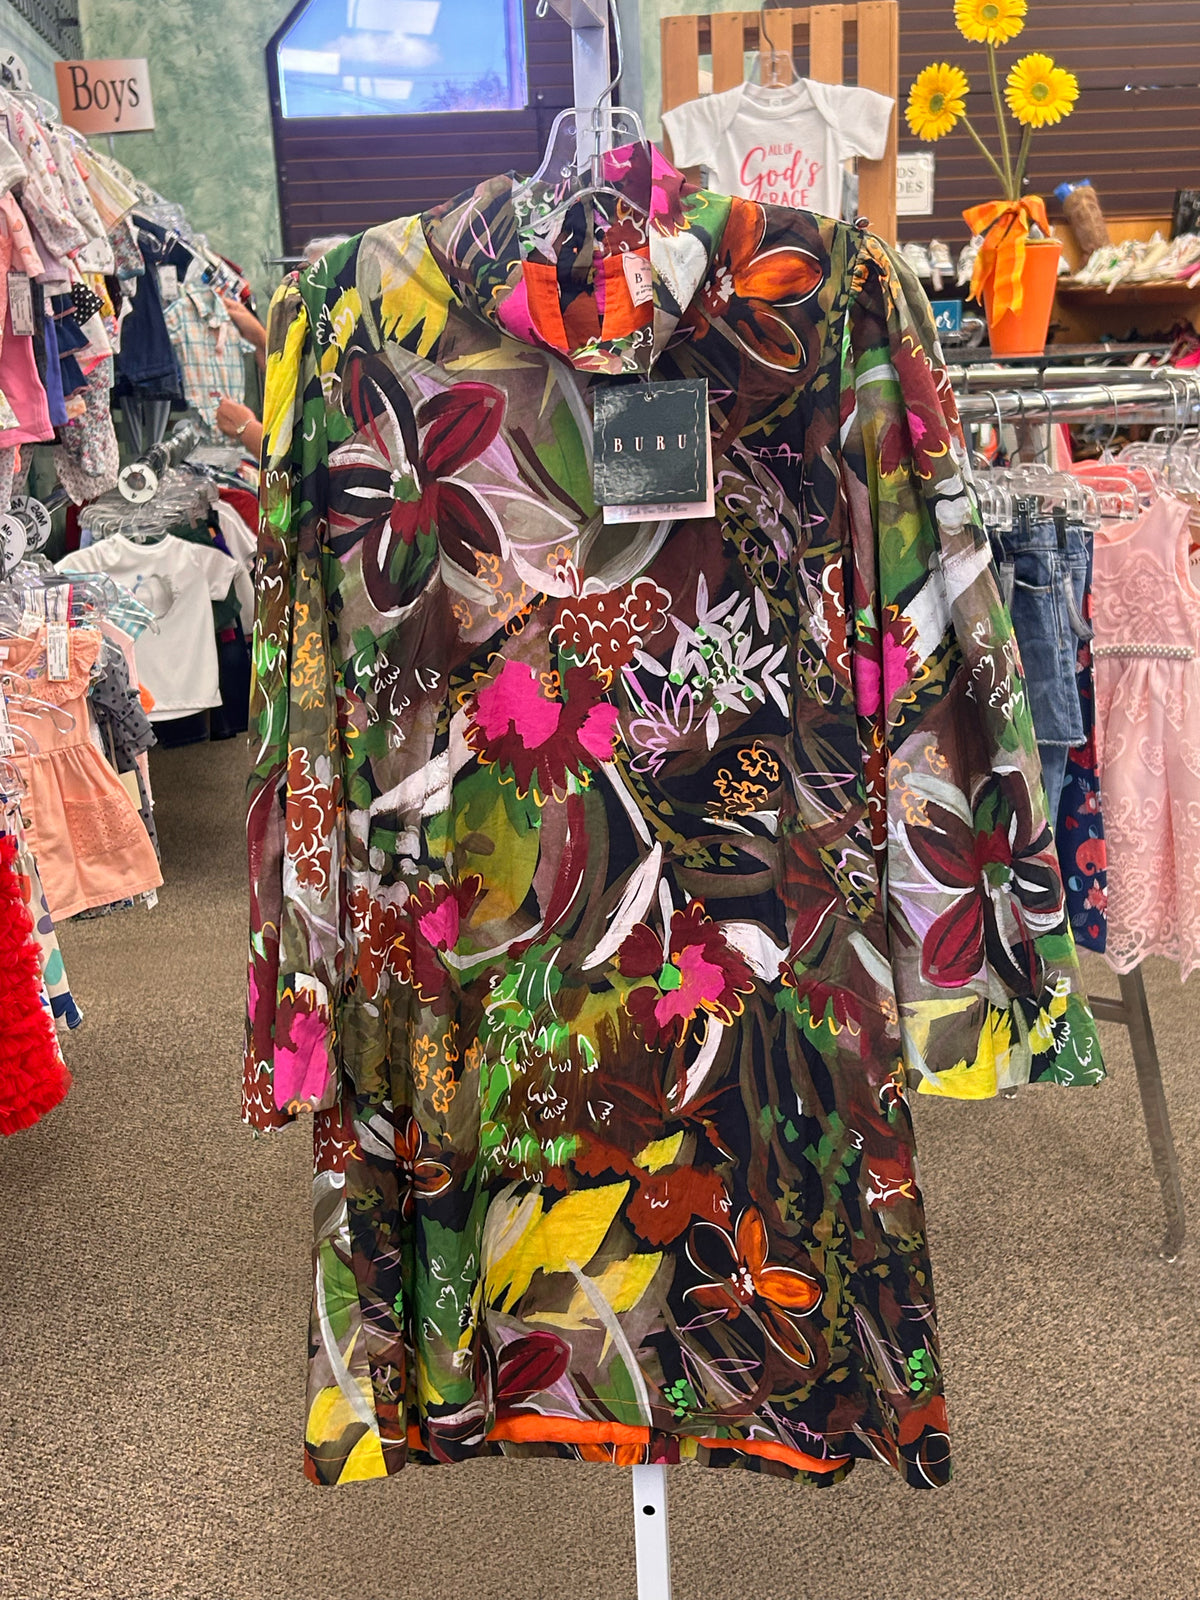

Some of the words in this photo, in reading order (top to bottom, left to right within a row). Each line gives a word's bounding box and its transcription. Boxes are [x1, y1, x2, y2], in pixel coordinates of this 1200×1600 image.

[68, 65, 140, 123] Boys
[768, 143, 784, 155] ALL
[741, 146, 824, 200] God's
[613, 433, 688, 453] BURU
[30, 504, 48, 527] 24M
